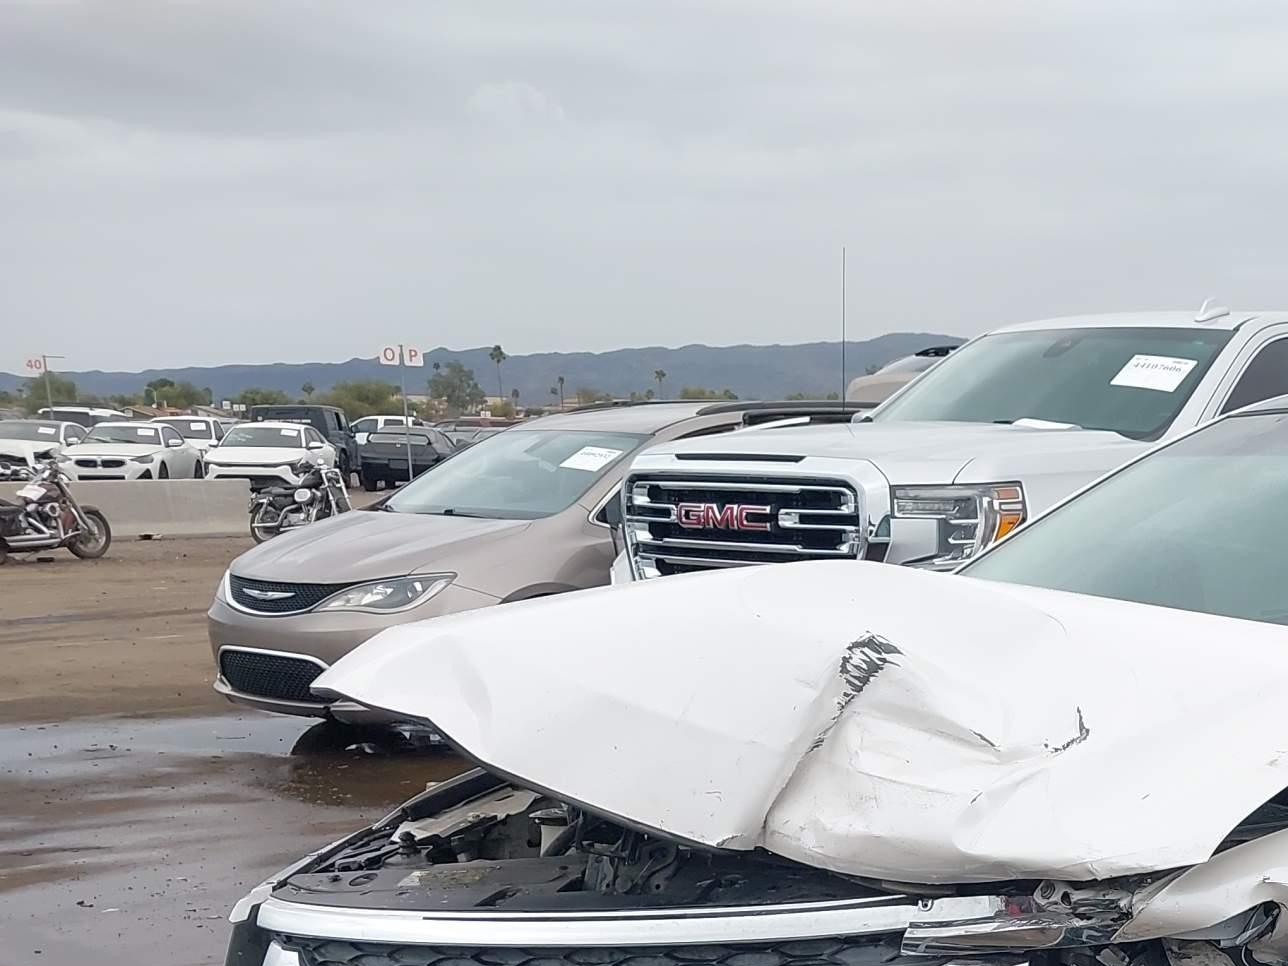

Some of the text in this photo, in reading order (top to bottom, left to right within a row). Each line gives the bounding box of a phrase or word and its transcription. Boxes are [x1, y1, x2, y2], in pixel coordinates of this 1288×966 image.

[408, 349, 418, 362] P
[26, 359, 42, 370] 40
[677, 502, 771, 530] GMC
